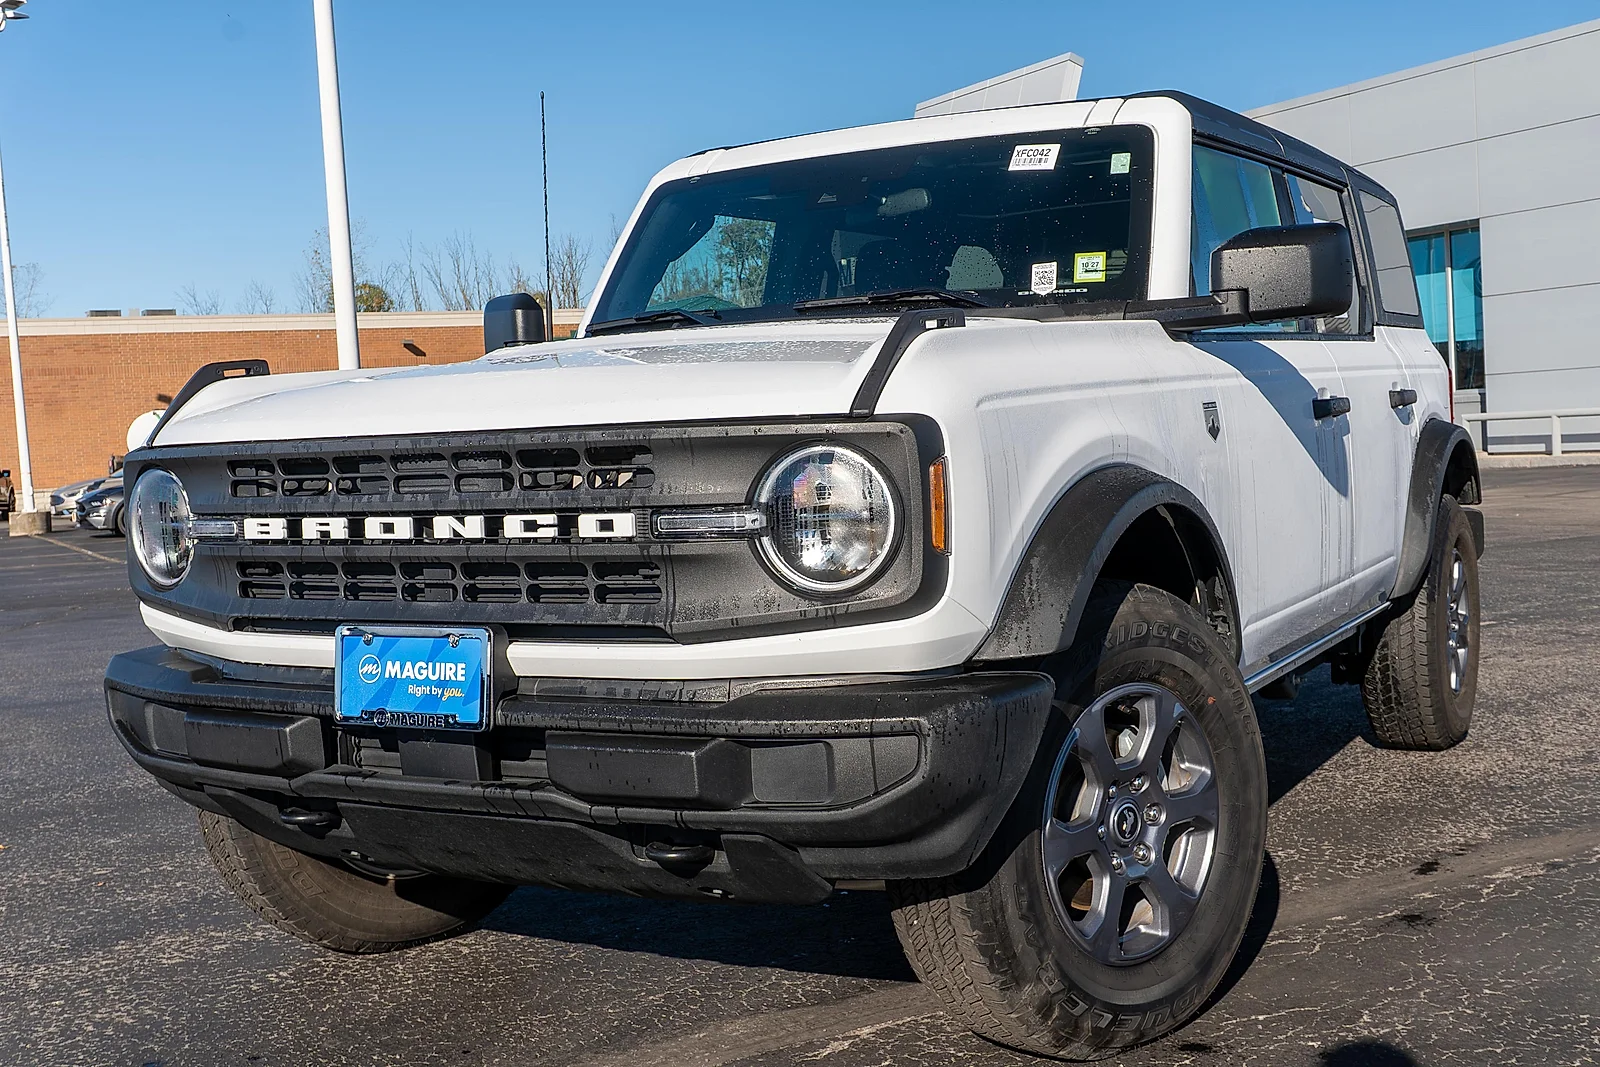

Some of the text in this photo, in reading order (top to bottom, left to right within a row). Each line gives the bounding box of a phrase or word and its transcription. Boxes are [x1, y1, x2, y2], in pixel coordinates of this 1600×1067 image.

[1015, 148, 1052, 158] XFC042
[243, 512, 637, 541] BRONCO
[384, 660, 466, 682] MAGUIRE
[407, 684, 465, 701] Right by you.
[389, 713, 446, 728] MAGUIRE
[1034, 960, 1198, 1032] DUELER
